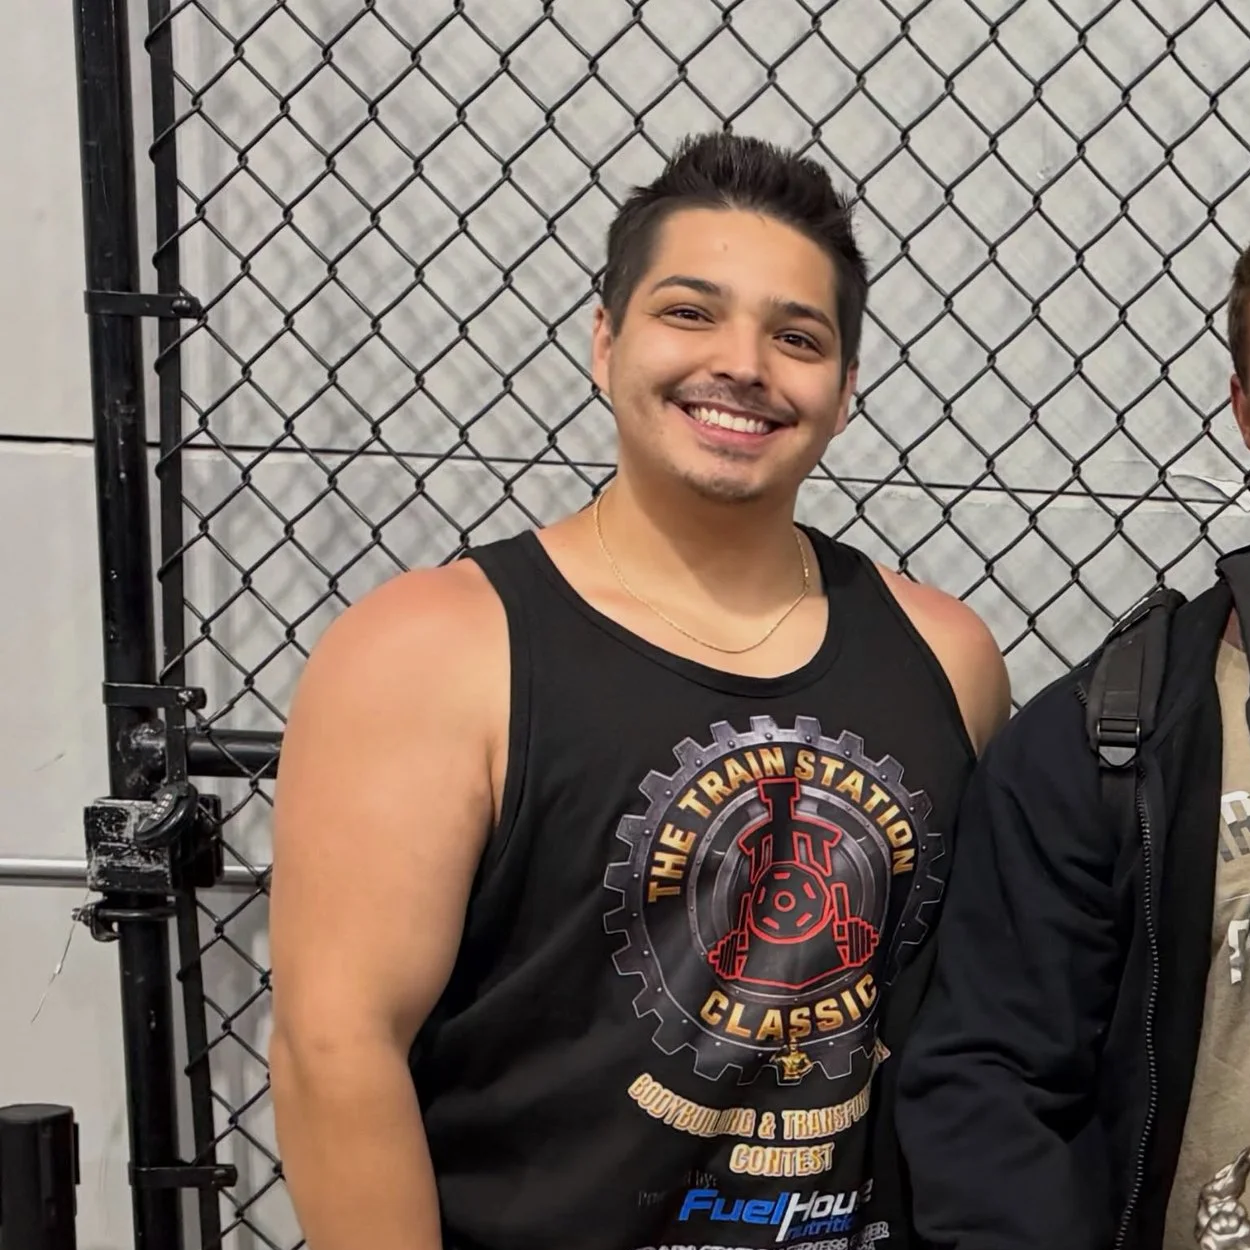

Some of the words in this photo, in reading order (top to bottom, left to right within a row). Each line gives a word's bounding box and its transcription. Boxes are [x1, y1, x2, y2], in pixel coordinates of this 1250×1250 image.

[647, 822, 697, 903] THE
[678, 747, 787, 820] TRAIN
[795, 750, 916, 876] STATION
[700, 974, 877, 1041] CLASSIC
[627, 1072, 756, 1137] BODYBUILING
[758, 1111, 776, 1140] &
[729, 1143, 835, 1177] CONTEST
[678, 1178, 874, 1242] FuelHoue
[784, 1214, 854, 1241] nutriti
